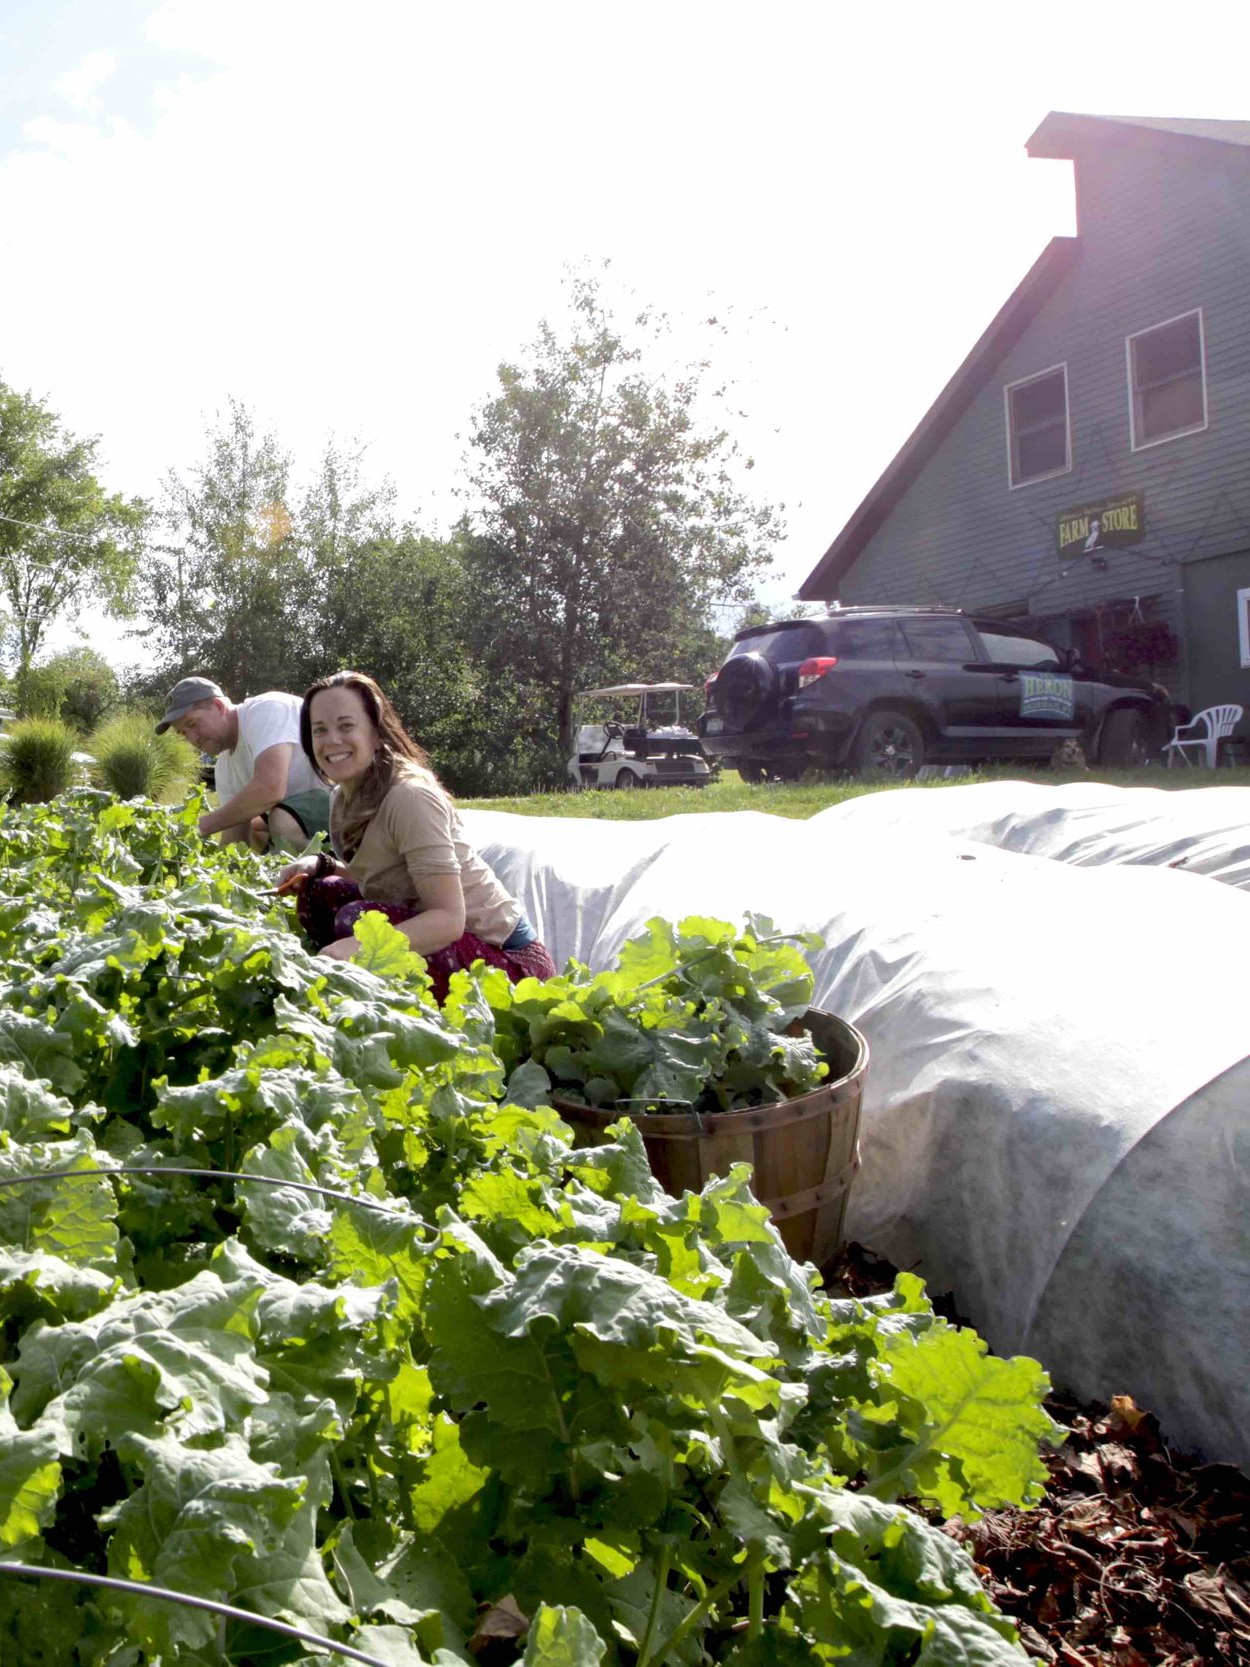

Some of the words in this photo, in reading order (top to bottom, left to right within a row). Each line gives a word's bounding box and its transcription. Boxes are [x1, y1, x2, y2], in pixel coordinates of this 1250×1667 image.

[1059, 517, 1090, 548] FARM
[1102, 505, 1138, 532] STORE
[1023, 677, 1072, 699] HERON
